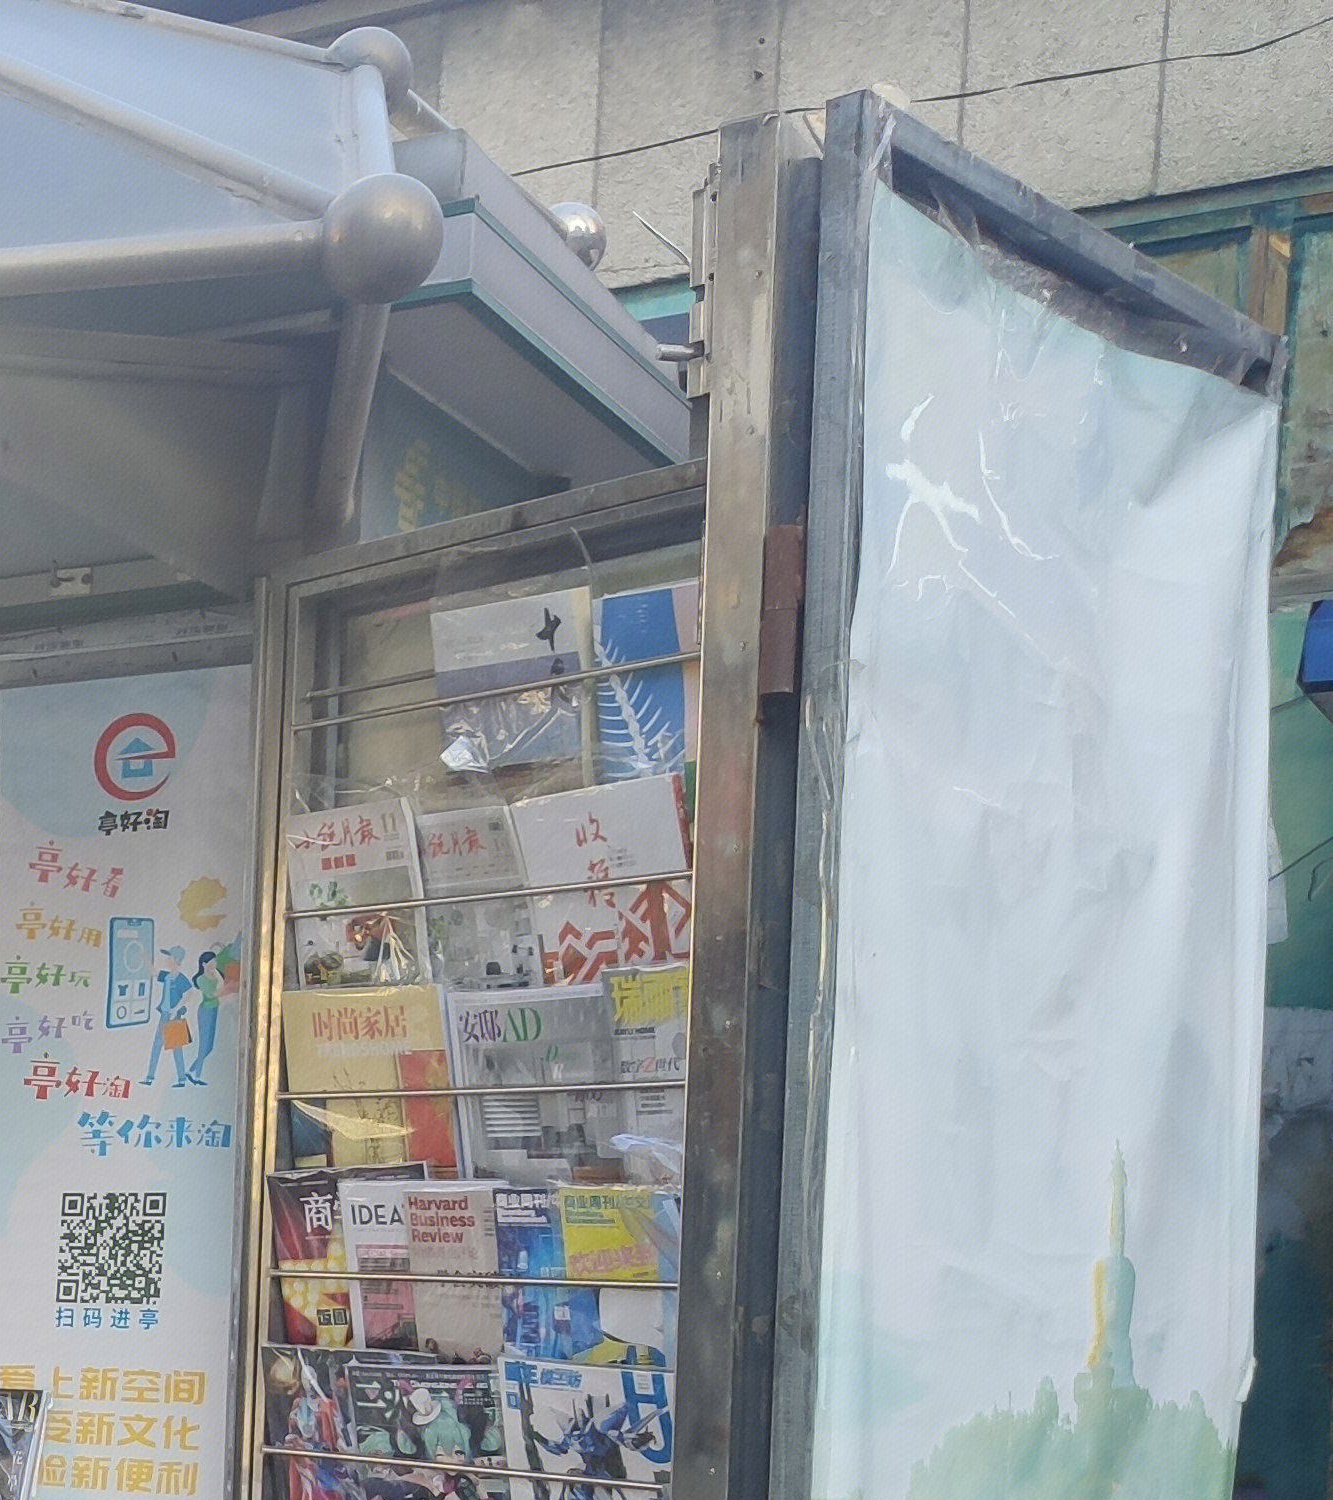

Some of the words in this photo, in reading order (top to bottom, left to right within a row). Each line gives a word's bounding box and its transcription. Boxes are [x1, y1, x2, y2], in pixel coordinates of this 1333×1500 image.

[97, 808, 170, 836] 亭好淘
[28, 841, 125, 900] 亭好看
[15, 902, 103, 949] 亭好用
[0, 955, 92, 995] 亭好玩
[0, 1010, 95, 1054] 亭好吃
[311, 1005, 408, 1041] 时尚家居
[501, 1008, 542, 1043] AD
[23, 1052, 131, 1100] 亭好淘
[76, 1110, 233, 1157] 等你来淘
[350, 1203, 404, 1226] IDEA
[408, 1195, 469, 1211] Harvard
[409, 1212, 475, 1228] Business
[411, 1228, 465, 1244] Review
[54, 1306, 160, 1330] 扫码进亭
